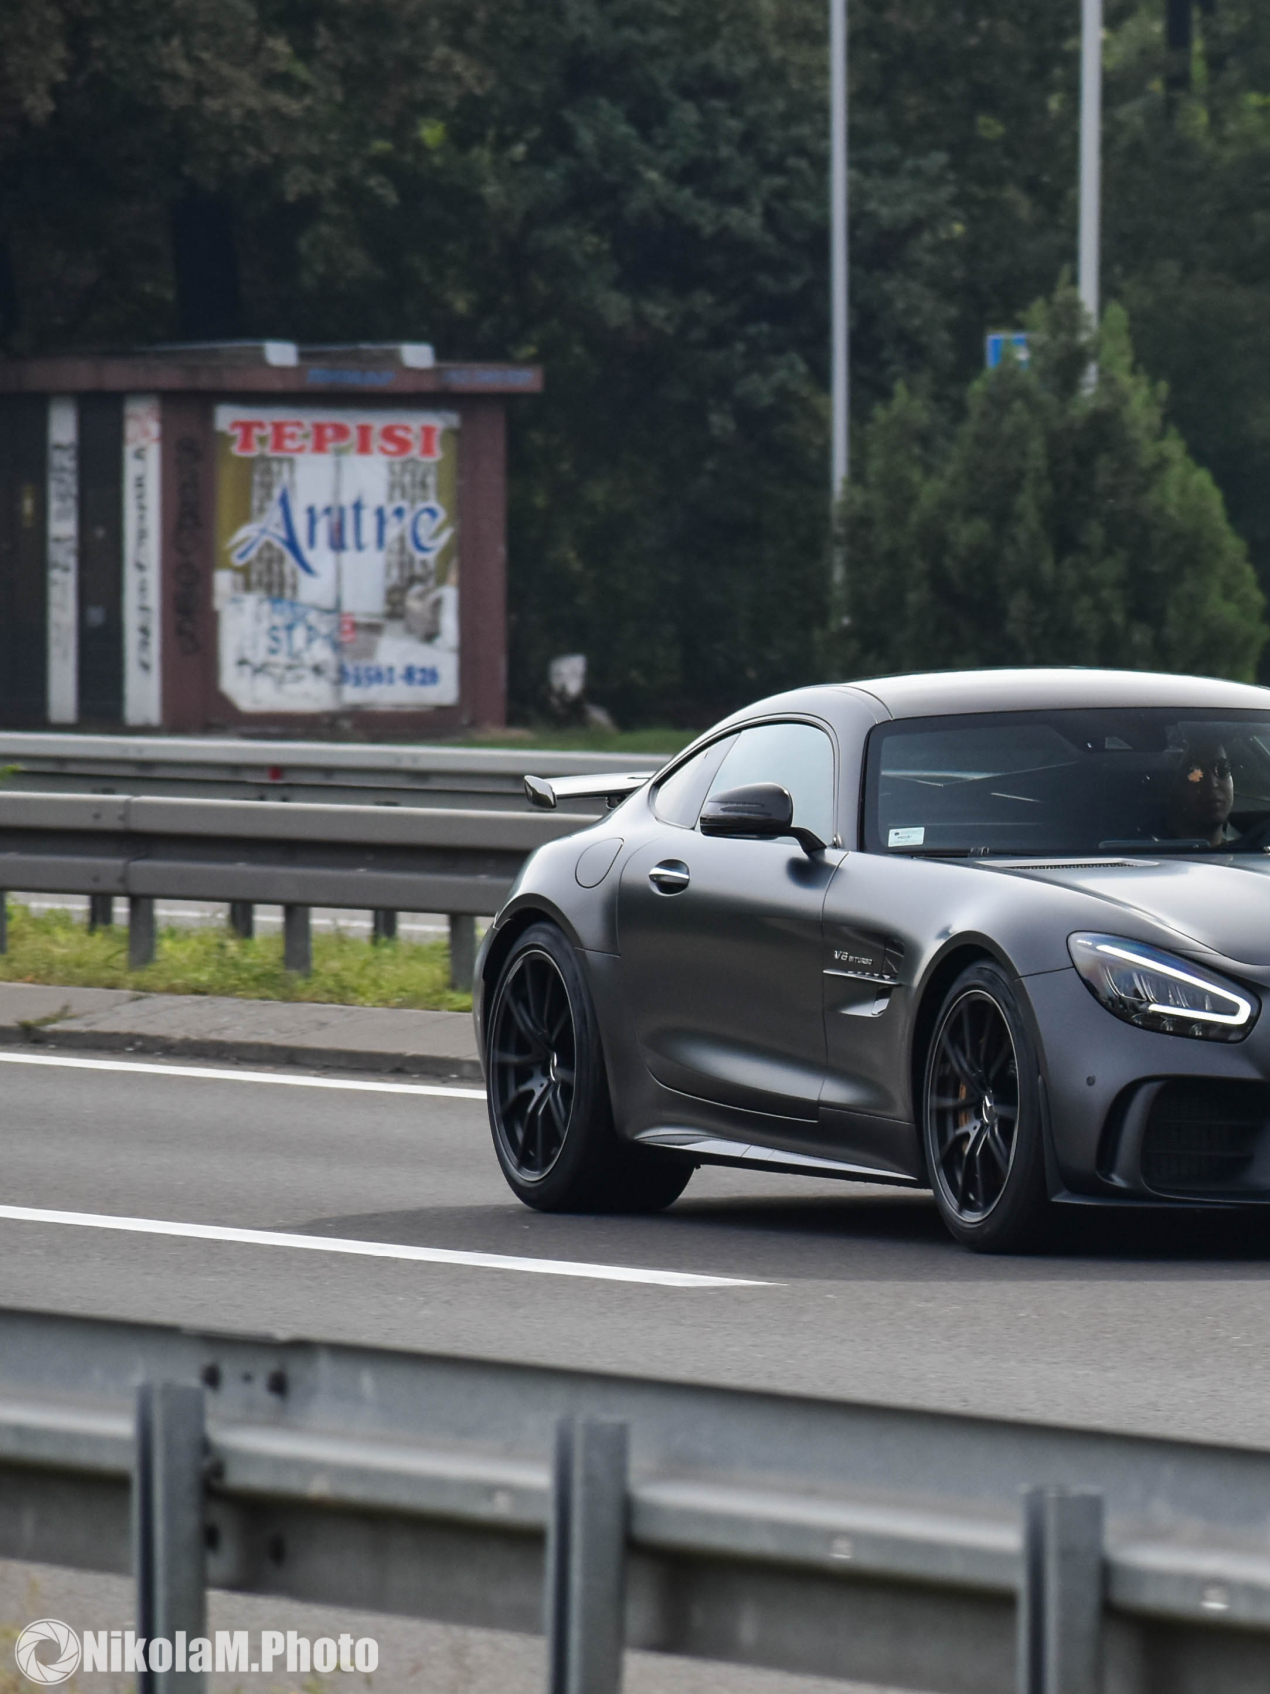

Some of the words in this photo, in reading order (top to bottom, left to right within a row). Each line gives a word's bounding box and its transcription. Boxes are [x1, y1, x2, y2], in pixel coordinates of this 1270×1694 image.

[229, 420, 440, 458] TEPISI
[233, 484, 444, 577] Antre
[834, 950, 849, 961] V8
